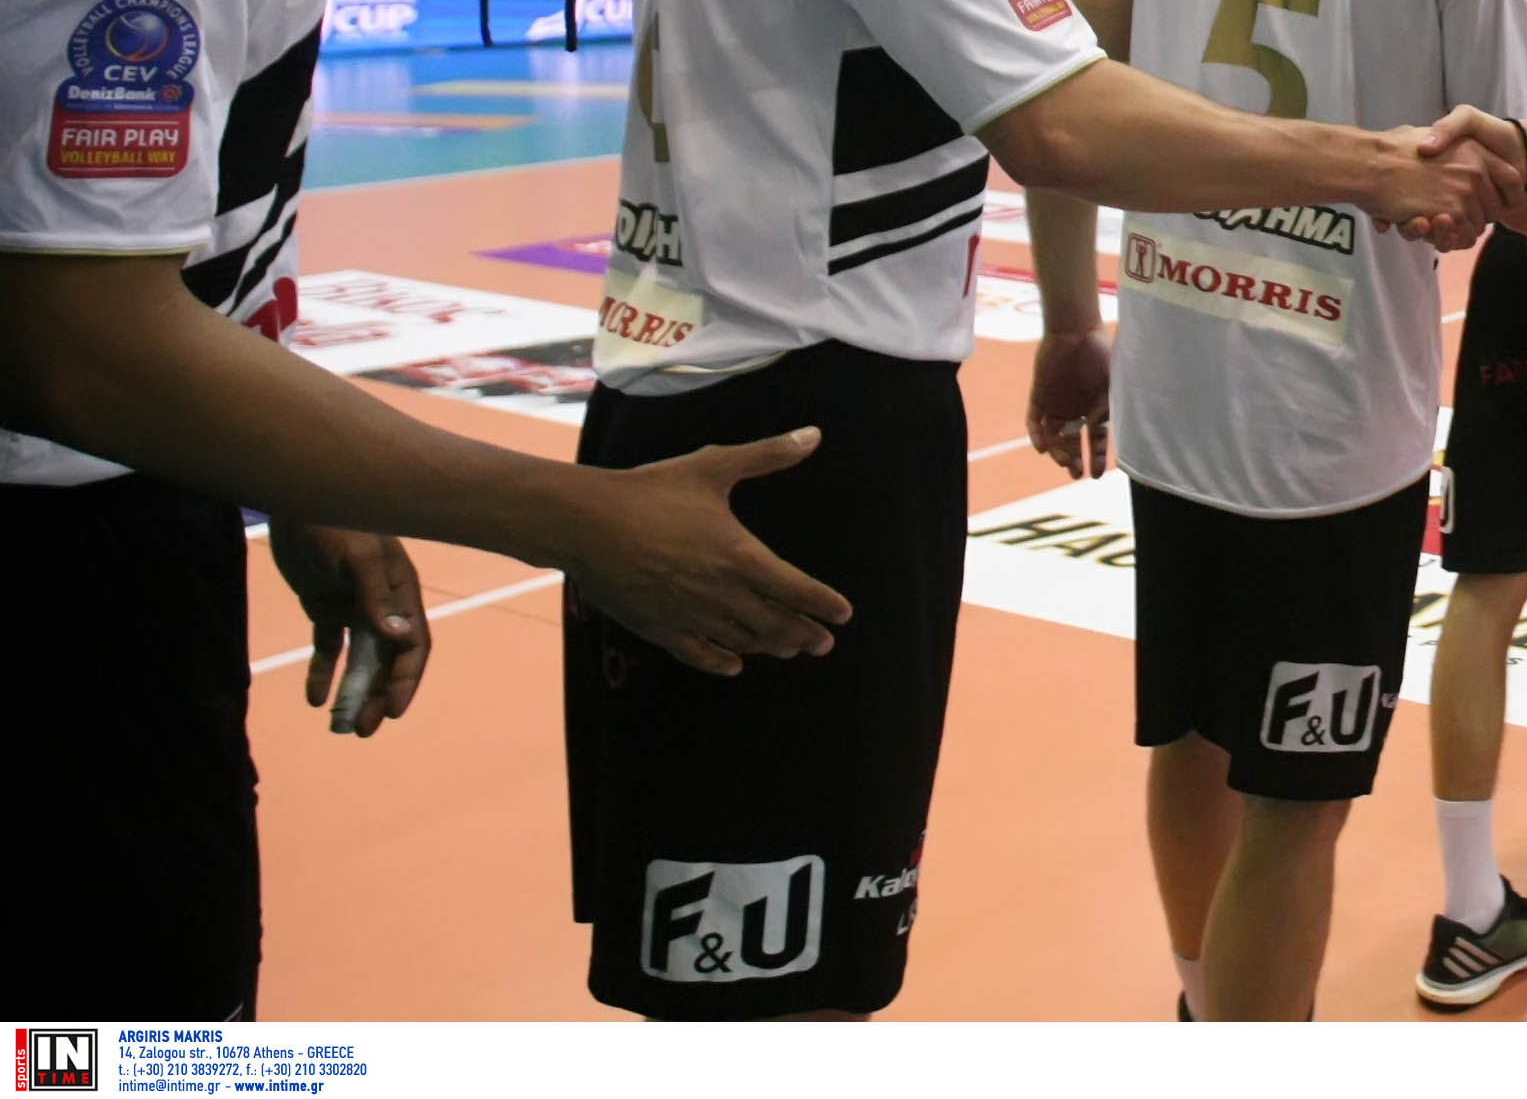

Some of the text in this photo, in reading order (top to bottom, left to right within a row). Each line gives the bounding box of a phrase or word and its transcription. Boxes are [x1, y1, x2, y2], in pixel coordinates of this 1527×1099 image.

[334, 2, 418, 36] CUP
[104, 64, 159, 82] CEV
[61, 128, 179, 147] FAIR PLAY
[61, 150, 177, 165] VOLLEYBALL WAY
[1157, 254, 1342, 322] MORRIS
[1267, 670, 1376, 747] F&U
[650, 861, 813, 975] F&U
